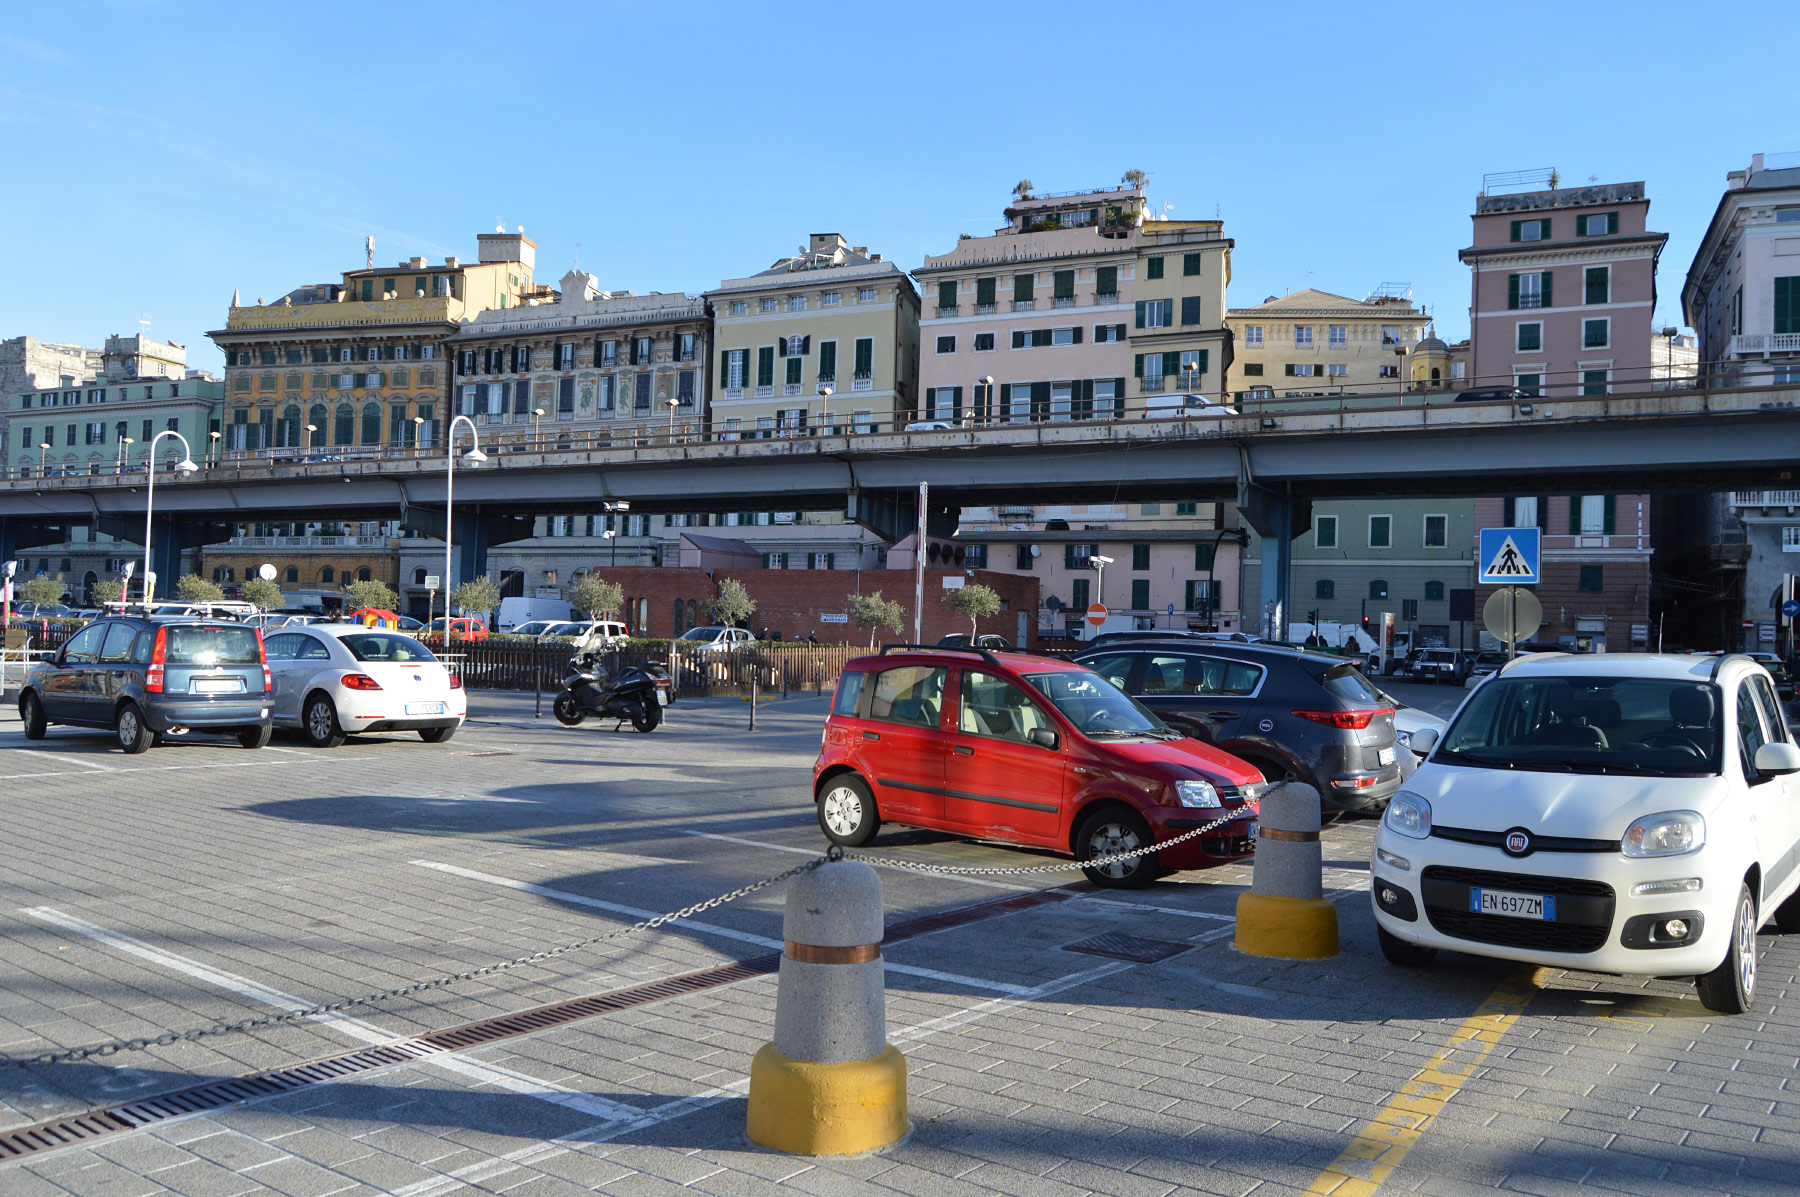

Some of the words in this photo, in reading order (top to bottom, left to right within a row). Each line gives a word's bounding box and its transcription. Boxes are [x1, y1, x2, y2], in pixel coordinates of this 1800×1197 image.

[1511, 837, 1524, 847] FIAT
[1482, 893, 1497, 909] EN
[1501, 896, 1542, 914] 697ZM
